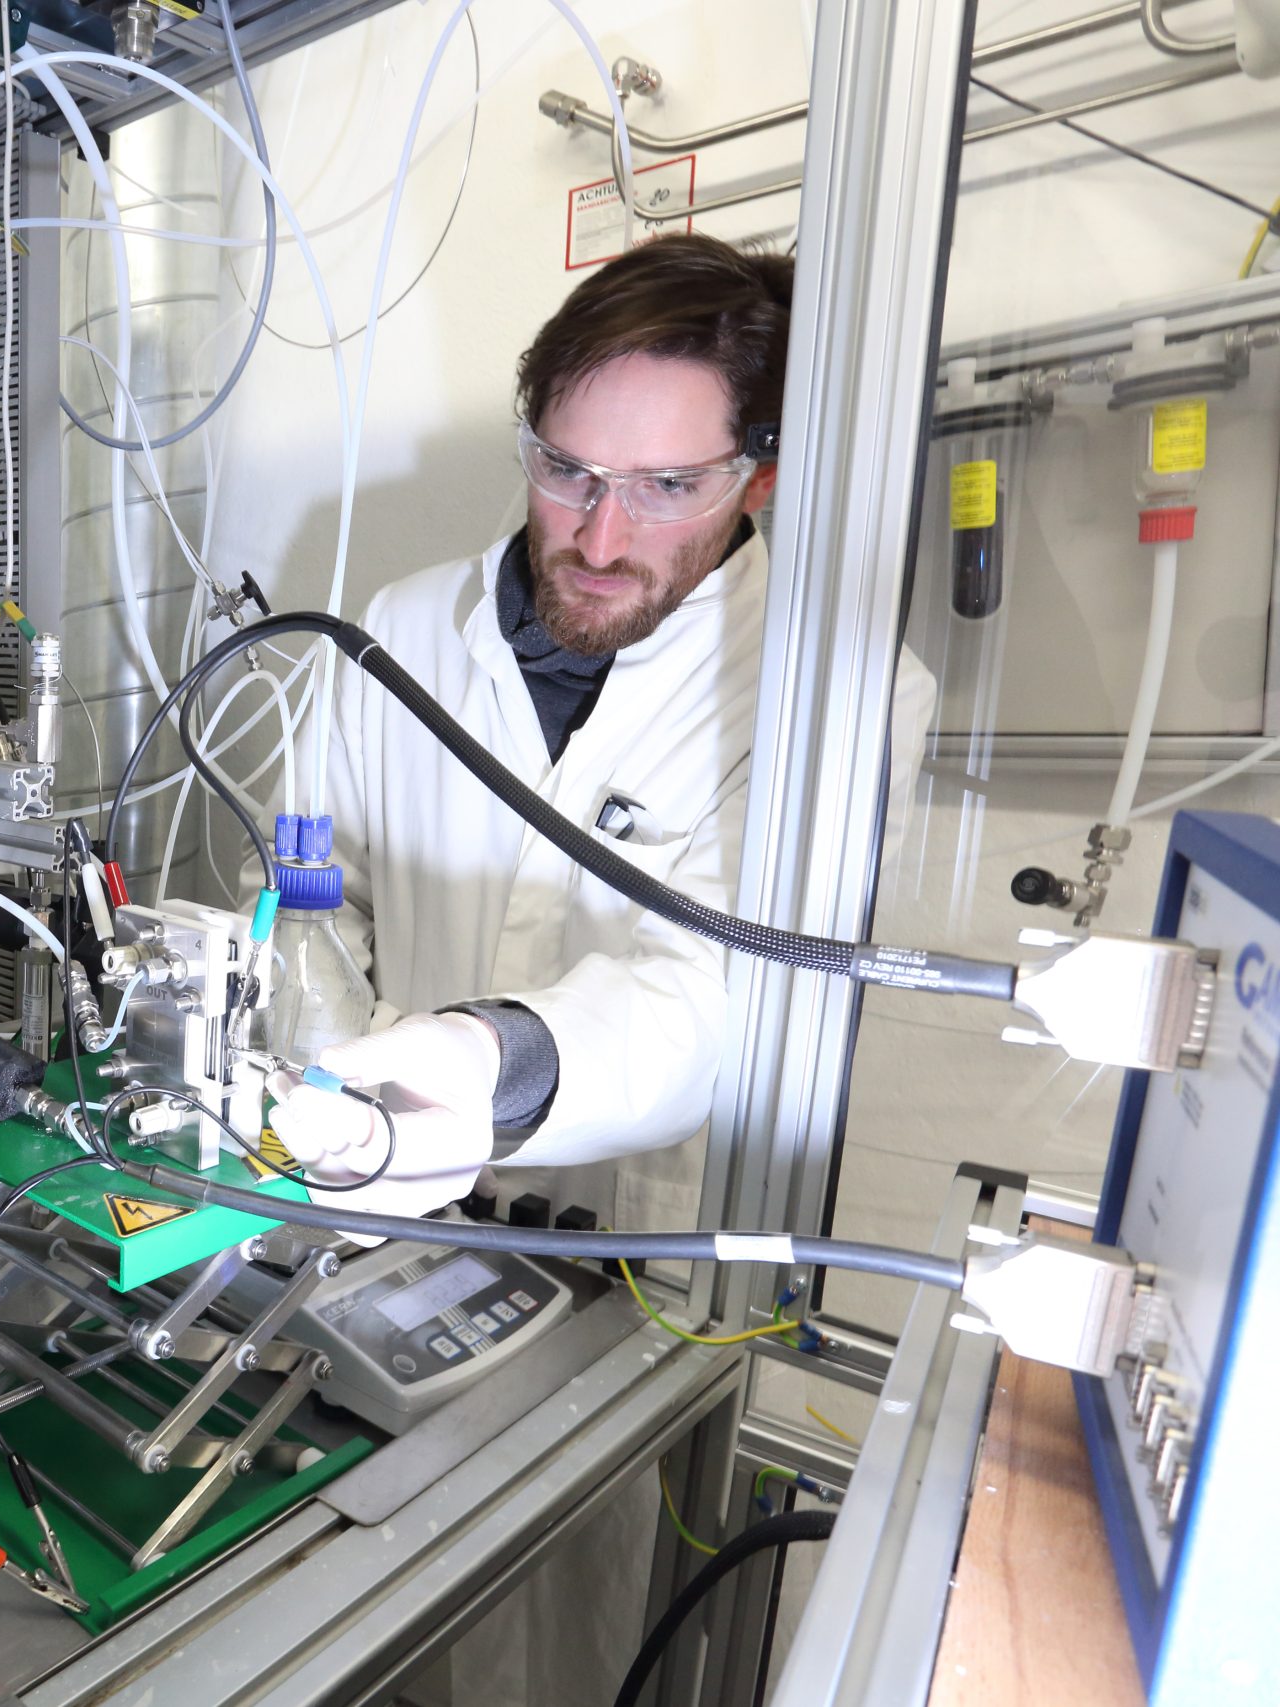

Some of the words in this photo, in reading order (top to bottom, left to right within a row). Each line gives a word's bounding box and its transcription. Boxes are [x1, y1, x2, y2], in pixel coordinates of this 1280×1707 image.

[195, 939, 202, 950] 4
[146, 985, 168, 1001] OUT
[323, 1300, 357, 1321] KERN
